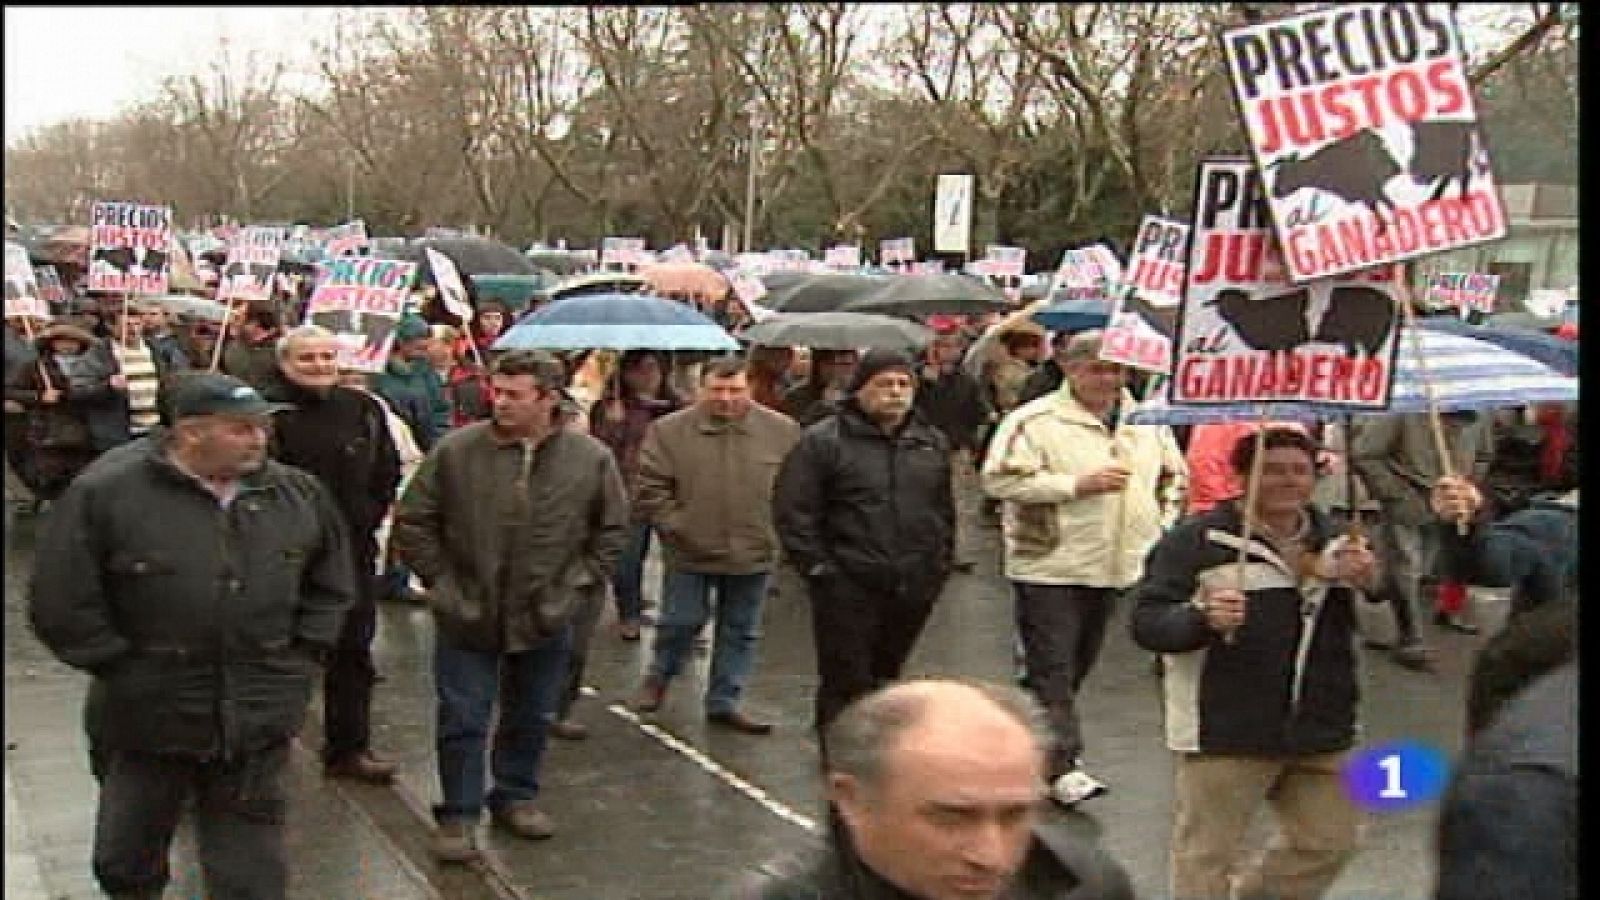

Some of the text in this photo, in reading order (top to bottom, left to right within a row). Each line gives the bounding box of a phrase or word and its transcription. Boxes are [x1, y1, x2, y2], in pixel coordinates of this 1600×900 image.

[1231, 3, 1450, 98] PRECIOS
[1257, 61, 1464, 154] JUSTOS
[93, 204, 168, 226] PRECIOS
[1286, 193, 1328, 228] al
[1287, 190, 1496, 276] GANADERO
[1187, 326, 1230, 353] al
[1180, 353, 1383, 401] GANADERO
